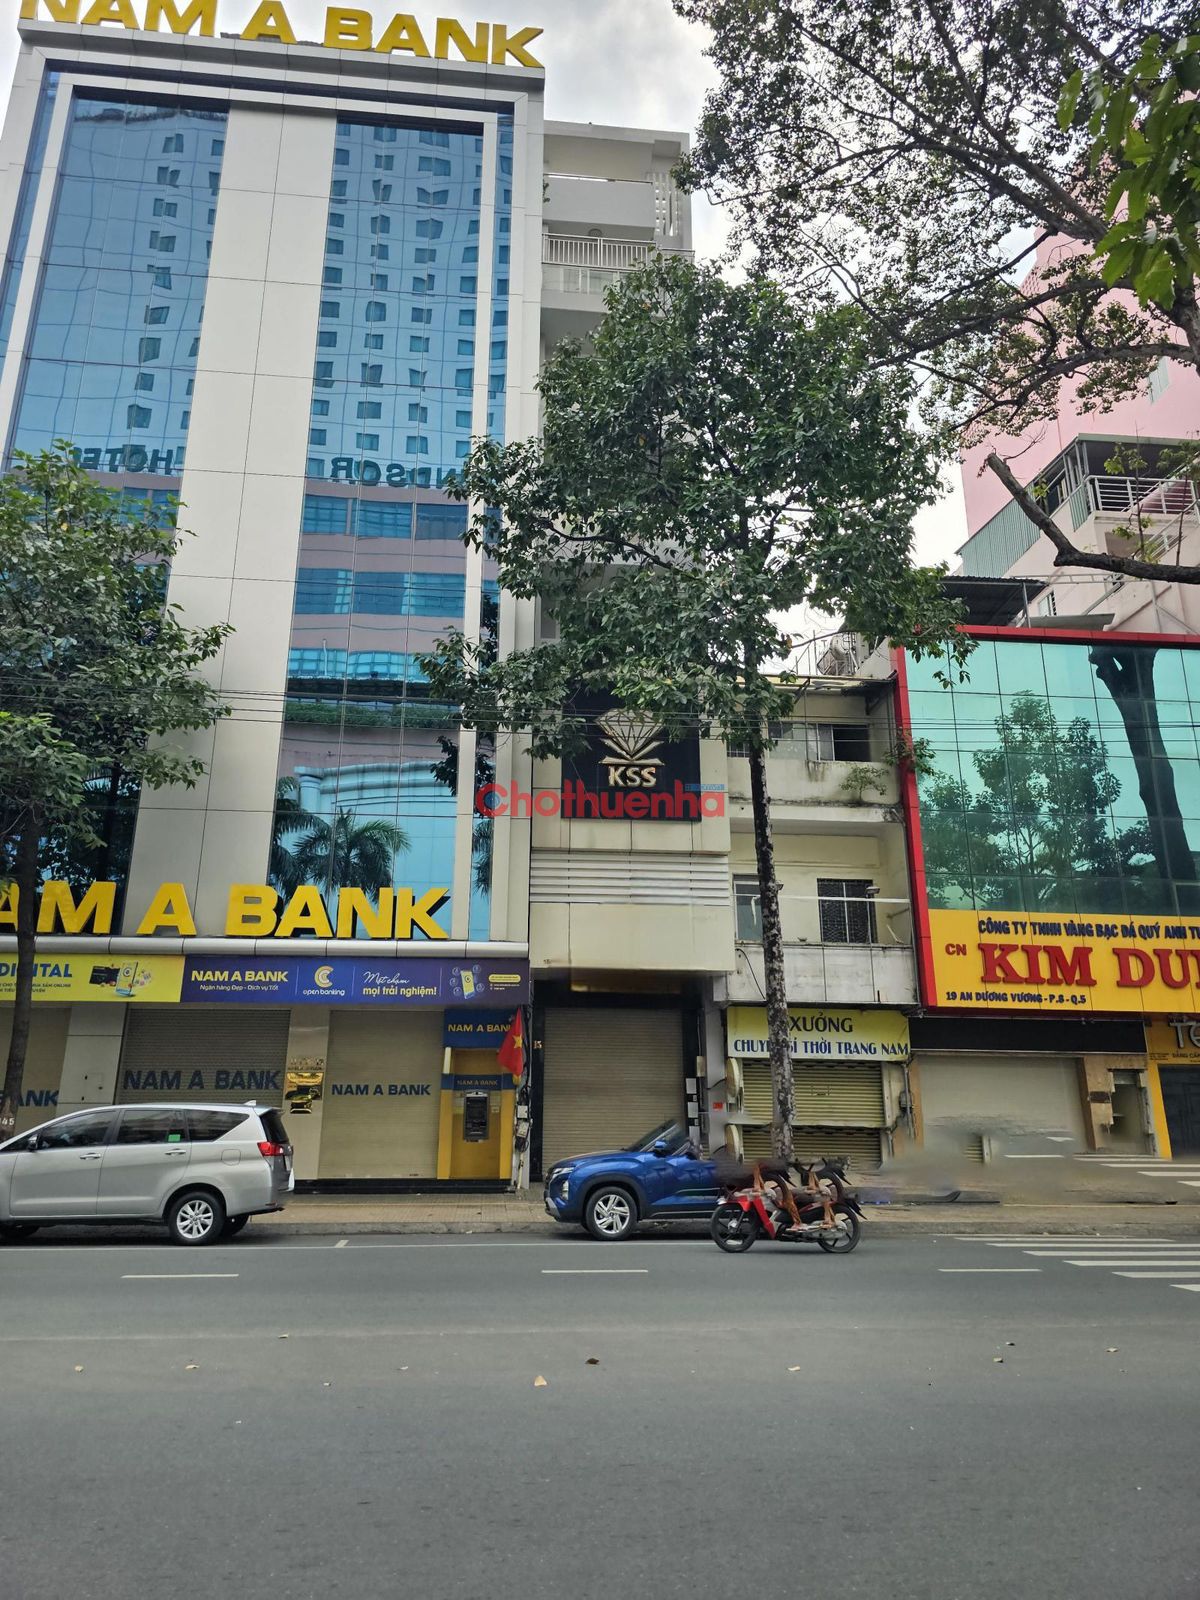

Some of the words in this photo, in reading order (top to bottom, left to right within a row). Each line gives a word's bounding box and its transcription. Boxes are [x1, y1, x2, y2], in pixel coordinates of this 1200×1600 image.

[240, 0, 298, 44] A
[323, 6, 545, 69] BANK
[608, 766, 657, 787] KSS
[136, 883, 197, 936] A
[224, 883, 450, 939] BANK
[978, 917, 1010, 934] CÔNG
[1012, 921, 1027, 935] TY
[1064, 919, 1094, 937] VÀNG
[1096, 923, 1119, 940] BẠC
[1138, 921, 1160, 940] QUÝ
[1164, 925, 1187, 939] ANH
[945, 943, 967, 955] CN
[0, 963, 72, 977] DIITAL
[978, 943, 1097, 987] KIM
[191, 970, 229, 981] NAM
[231, 971, 242, 981] A
[245, 971, 288, 982] BANK
[320, 988, 345, 996] banking
[363, 986, 380, 997] mọi
[382, 984, 398, 995] trải
[400, 985, 437, 997] nghiệm!
[946, 991, 957, 1001] 19
[960, 992, 973, 1001] AN
[975, 991, 1009, 1002] DƯƠNG
[1010, 992, 1043, 1003] VƯƠNG
[1070, 994, 1087, 1005] Q.5
[448, 1024, 473, 1032] NAM
[476, 1024, 484, 1032] A
[486, 1024, 511, 1032] BAN
[789, 1012, 853, 1033] XƯỞNG
[533, 1040, 542, 1050] 15
[802, 1037, 832, 1055] THỜI
[836, 1041, 877, 1056] TRANG
[881, 1043, 908, 1056] NAM
[123, 1070, 181, 1090] NAM
[187, 1070, 205, 1090] A
[214, 1070, 281, 1090] BANK
[331, 1084, 369, 1096] NAM
[373, 1084, 384, 1096] A
[388, 1084, 431, 1096] BANK
